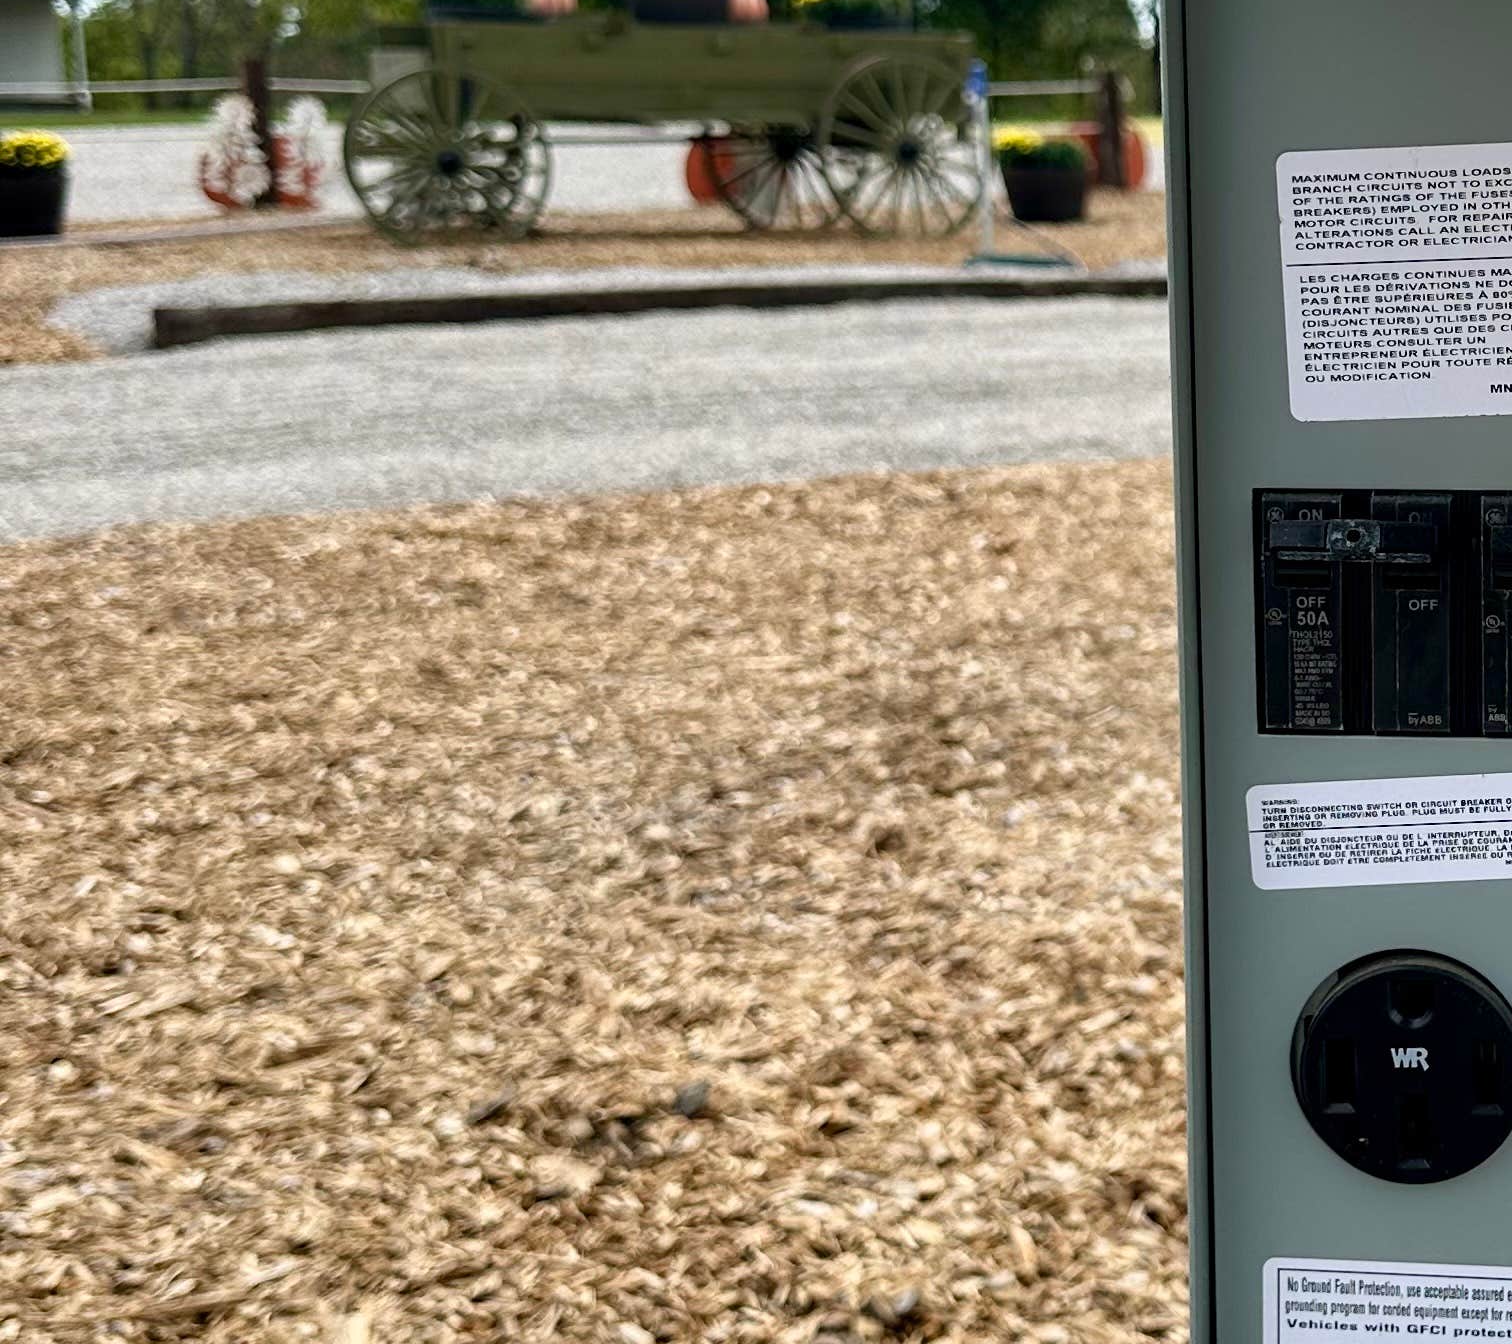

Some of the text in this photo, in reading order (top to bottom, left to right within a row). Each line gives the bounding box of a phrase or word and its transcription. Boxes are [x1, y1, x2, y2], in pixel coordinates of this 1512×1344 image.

[1292, 174, 1360, 183] MAXIMUM
[1364, 170, 1458, 180] CONTINUOUS
[1463, 168, 1511, 177] LOADS
[1293, 185, 1352, 195] BRANCH
[1357, 183, 1422, 192] CIRCUITS
[1428, 181, 1456, 189] NOT
[1462, 180, 1480, 188] TO
[1293, 198, 1311, 206] OF
[1317, 197, 1343, 205] THE
[1349, 194, 1411, 203] RATINGS
[1416, 193, 1434, 201] OF
[1440, 192, 1466, 200] THE
[1294, 207, 1376, 217] BREAKERS)
[1381, 204, 1459, 214] EMPLOYED
[1294, 219, 1345, 228] MOTOR
[1350, 217, 1416, 226] CIRCUITS
[1429, 215, 1458, 223] FOR
[1295, 229, 1394, 239] ALTERATIONS
[1398, 227, 1435, 236] CALL
[1440, 226, 1459, 234] AN
[1296, 240, 1394, 250] CONTRACTOR
[1398, 239, 1418, 247] OR
[1300, 276, 1326, 284] LES
[1331, 273, 1400, 282] CHARGES
[1404, 270, 1486, 279] CONTINUES
[1301, 286, 1340, 294] POUR
[1345, 285, 1371, 293] LES
[1376, 282, 1470, 292] DÉRIVATIONS
[1305, 375, 1325, 383] OU
[1298, 508, 1323, 520] ON
[1296, 596, 1328, 608] OFF
[1408, 598, 1439, 610] OFF
[1296, 610, 1329, 626] 50A
[1419, 714, 1442, 725] ABB
[1390, 1047, 1430, 1072] WR
[1287, 1277, 1299, 1292] No
[1301, 1277, 1331, 1293] Ground
[1335, 1279, 1356, 1295] Fault
[1359, 1280, 1403, 1297] Protection,
[1407, 1286, 1421, 1298] use
[1424, 1285, 1469, 1301] acceptable
[1472, 1287, 1504, 1302] assured
[1285, 1300, 1328, 1315] grounding
[1330, 1303, 1366, 1317] program
[1368, 1302, 1380, 1315] for
[1383, 1304, 1411, 1317] corded
[1414, 1307, 1458, 1320] equipment
[1461, 1308, 1488, 1323] except
[1491, 1308, 1504, 1321] for
[1287, 1319, 1358, 1331] Vehicles
[1365, 1324, 1400, 1333] with
[1407, 1324, 1446, 1335] GFCI
